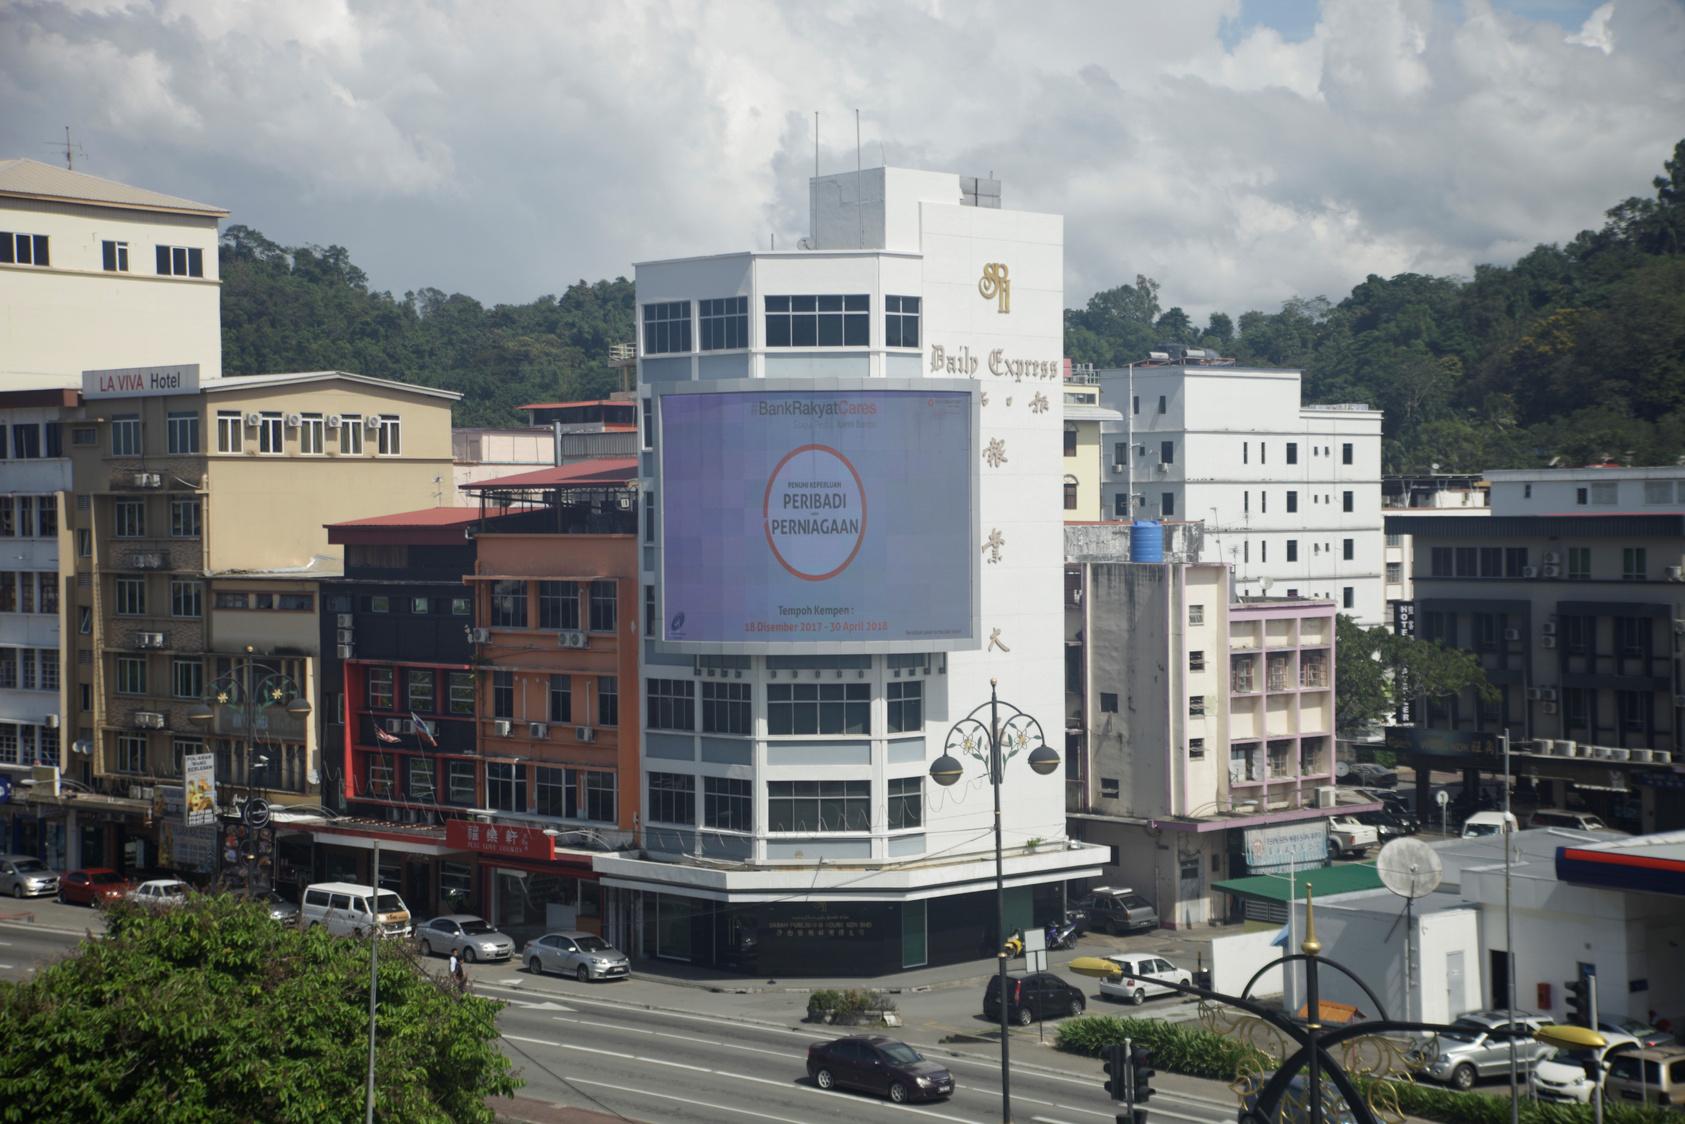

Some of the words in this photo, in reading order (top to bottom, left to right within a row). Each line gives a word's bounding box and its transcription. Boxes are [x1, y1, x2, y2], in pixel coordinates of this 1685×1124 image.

[930, 343, 979, 379] Daily
[988, 348, 1058, 383] Express
[99, 376, 115, 392] LA
[118, 374, 144, 391] VIVA
[150, 371, 181, 389] Hotel
[783, 493, 847, 509] PERIBADI
[771, 518, 859, 536] PERNIAGAAN
[778, 605, 812, 617] Tempoh
[813, 605, 850, 617] Kempen
[799, 622, 822, 632] 2017
[842, 621, 864, 634] April
